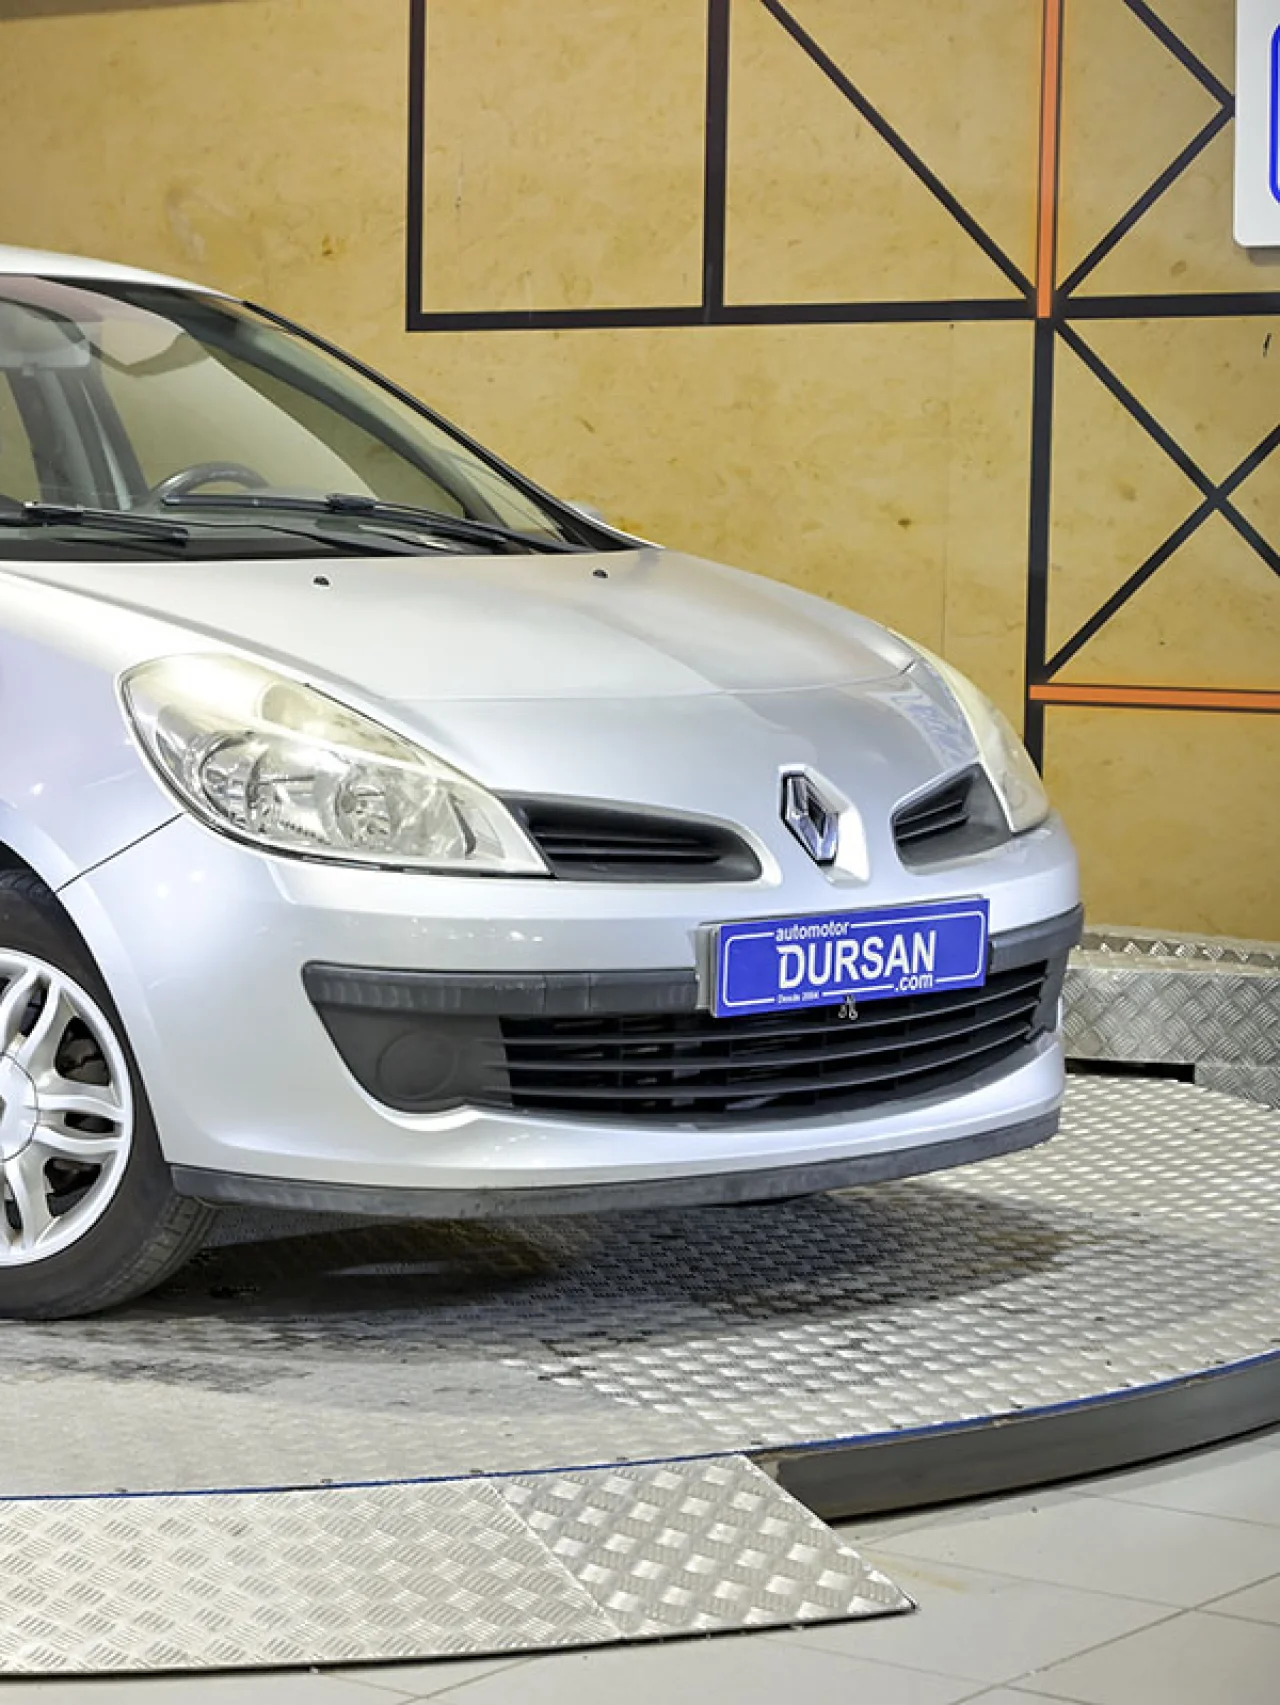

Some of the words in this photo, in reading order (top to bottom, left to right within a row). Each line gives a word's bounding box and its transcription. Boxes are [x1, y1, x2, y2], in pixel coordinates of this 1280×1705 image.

[775, 920, 850, 942] automotor
[775, 929, 937, 989] DURSAN
[893, 973, 934, 992] .com
